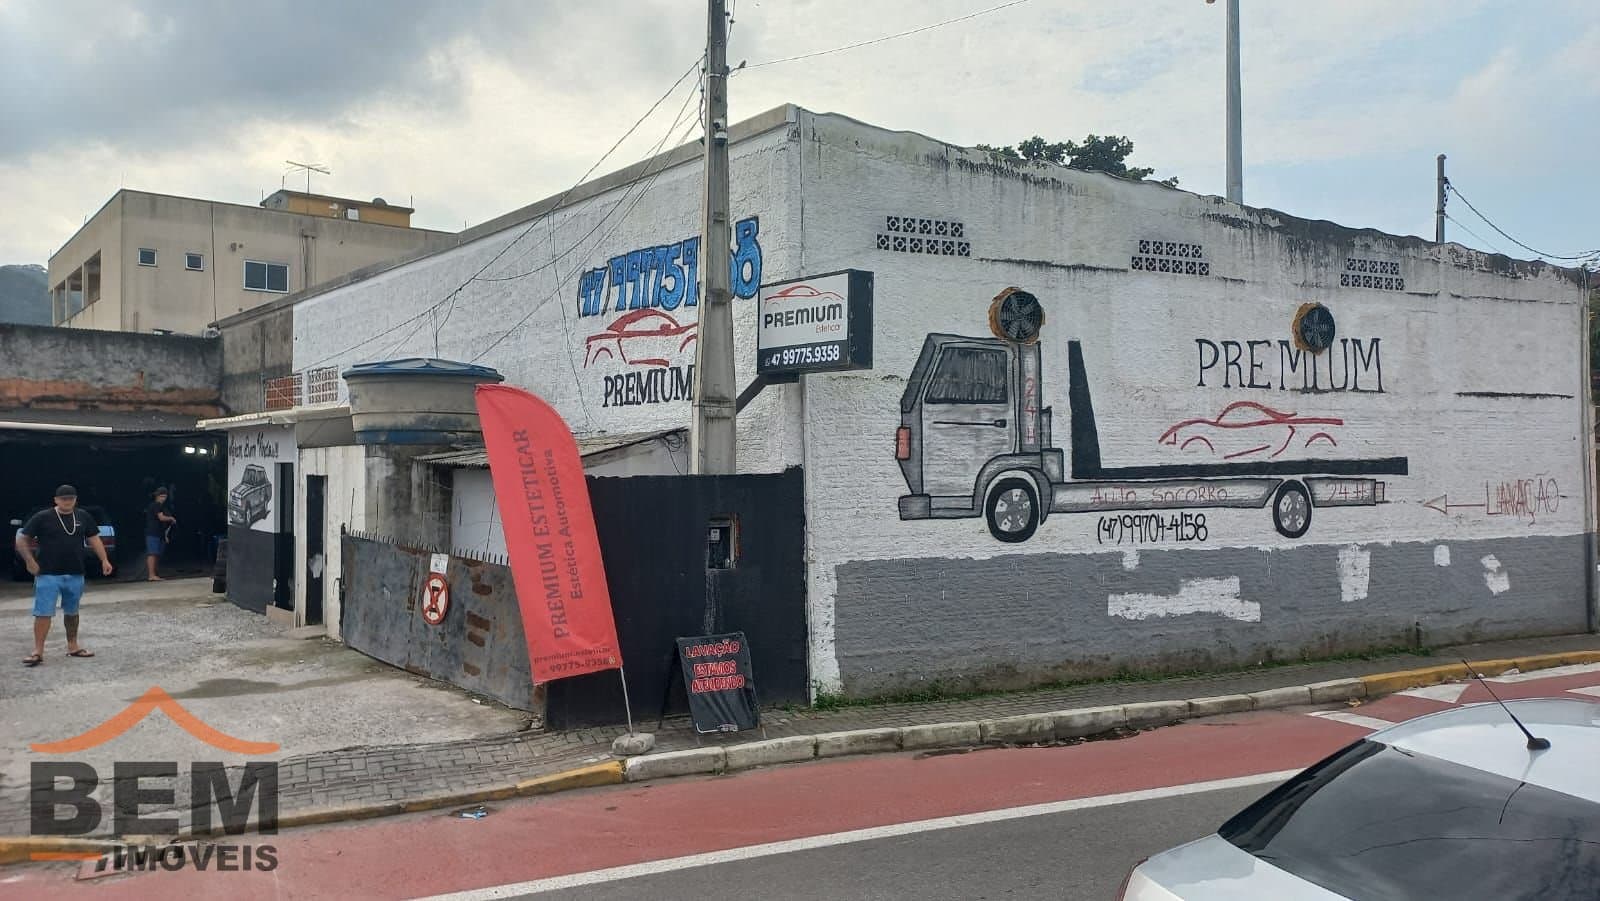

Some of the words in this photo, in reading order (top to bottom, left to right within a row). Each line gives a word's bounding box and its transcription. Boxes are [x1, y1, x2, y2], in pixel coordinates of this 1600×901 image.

[764, 303, 843, 329] PREMIUM
[771, 354, 781, 366] 47
[783, 345, 840, 365] 99775.9358
[1195, 338, 1385, 393] PREMIUM
[602, 364, 696, 407] PREMIUM
[513, 428, 550, 538] ESTETICAR
[544, 447, 570, 538] Automotiva
[1098, 512, 1208, 544] (47)99704-4158
[536, 543, 570, 639] PREMIUM
[563, 541, 583, 600] Estética
